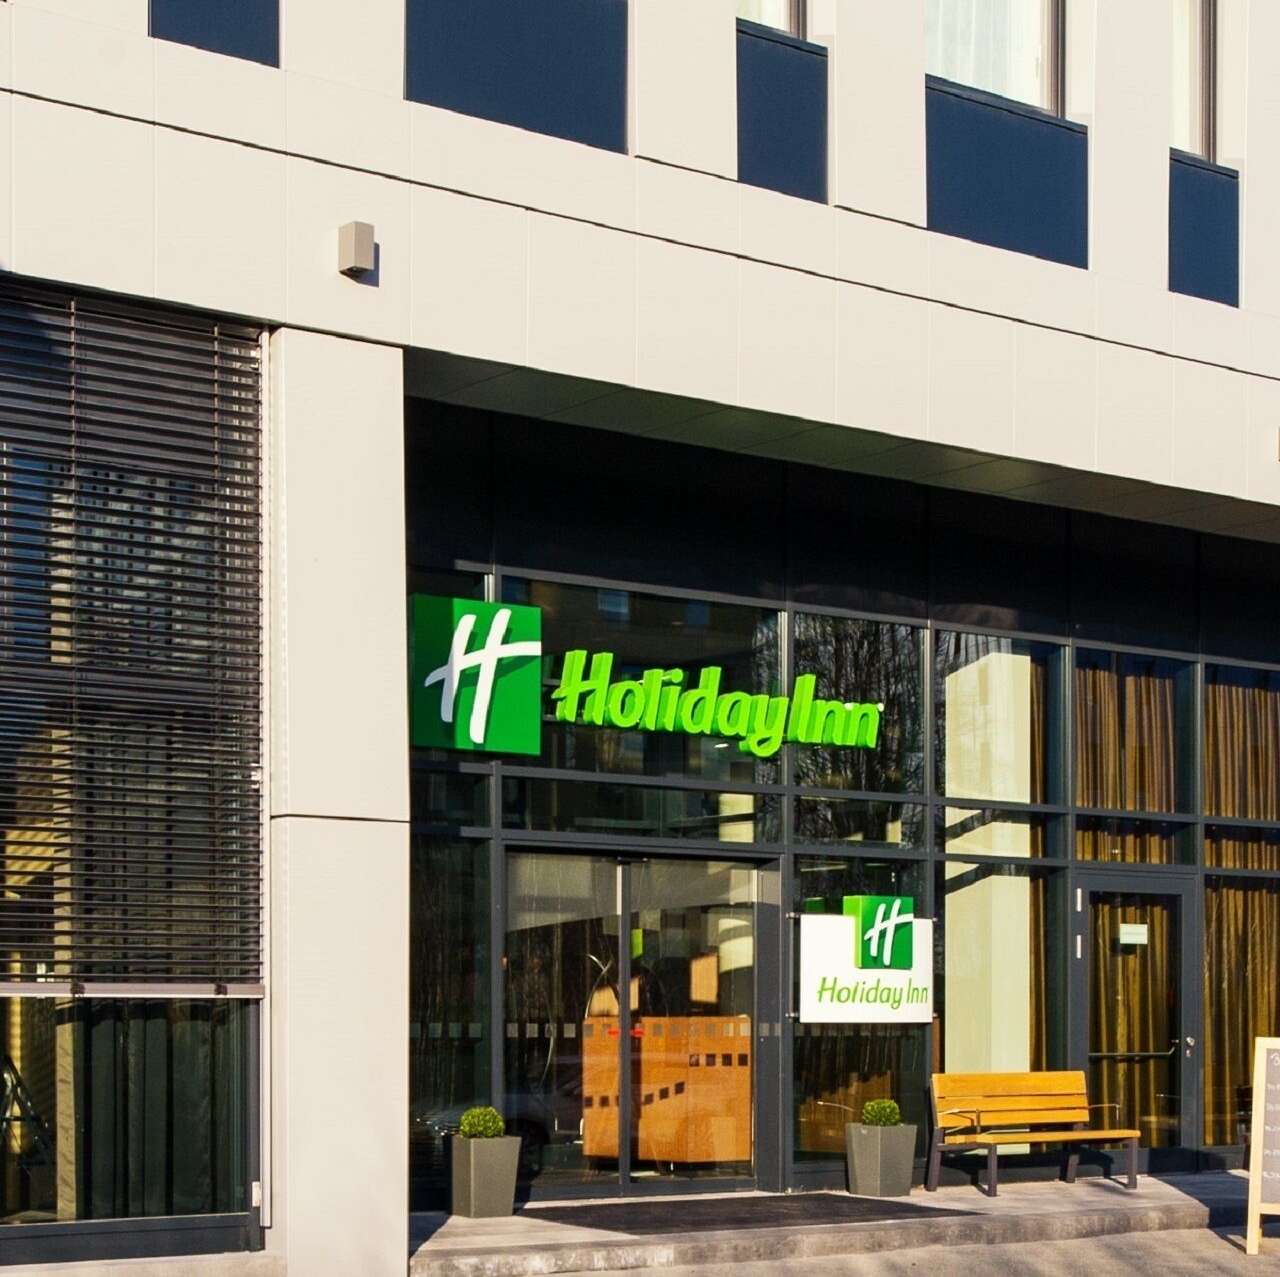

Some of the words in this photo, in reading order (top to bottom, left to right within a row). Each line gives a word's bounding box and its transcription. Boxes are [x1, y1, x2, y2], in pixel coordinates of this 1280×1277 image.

[552, 649, 789, 758] Holiday
[787, 673, 881, 749] Inn
[816, 976, 903, 1010] Holiday
[906, 977, 929, 1004] Inn
